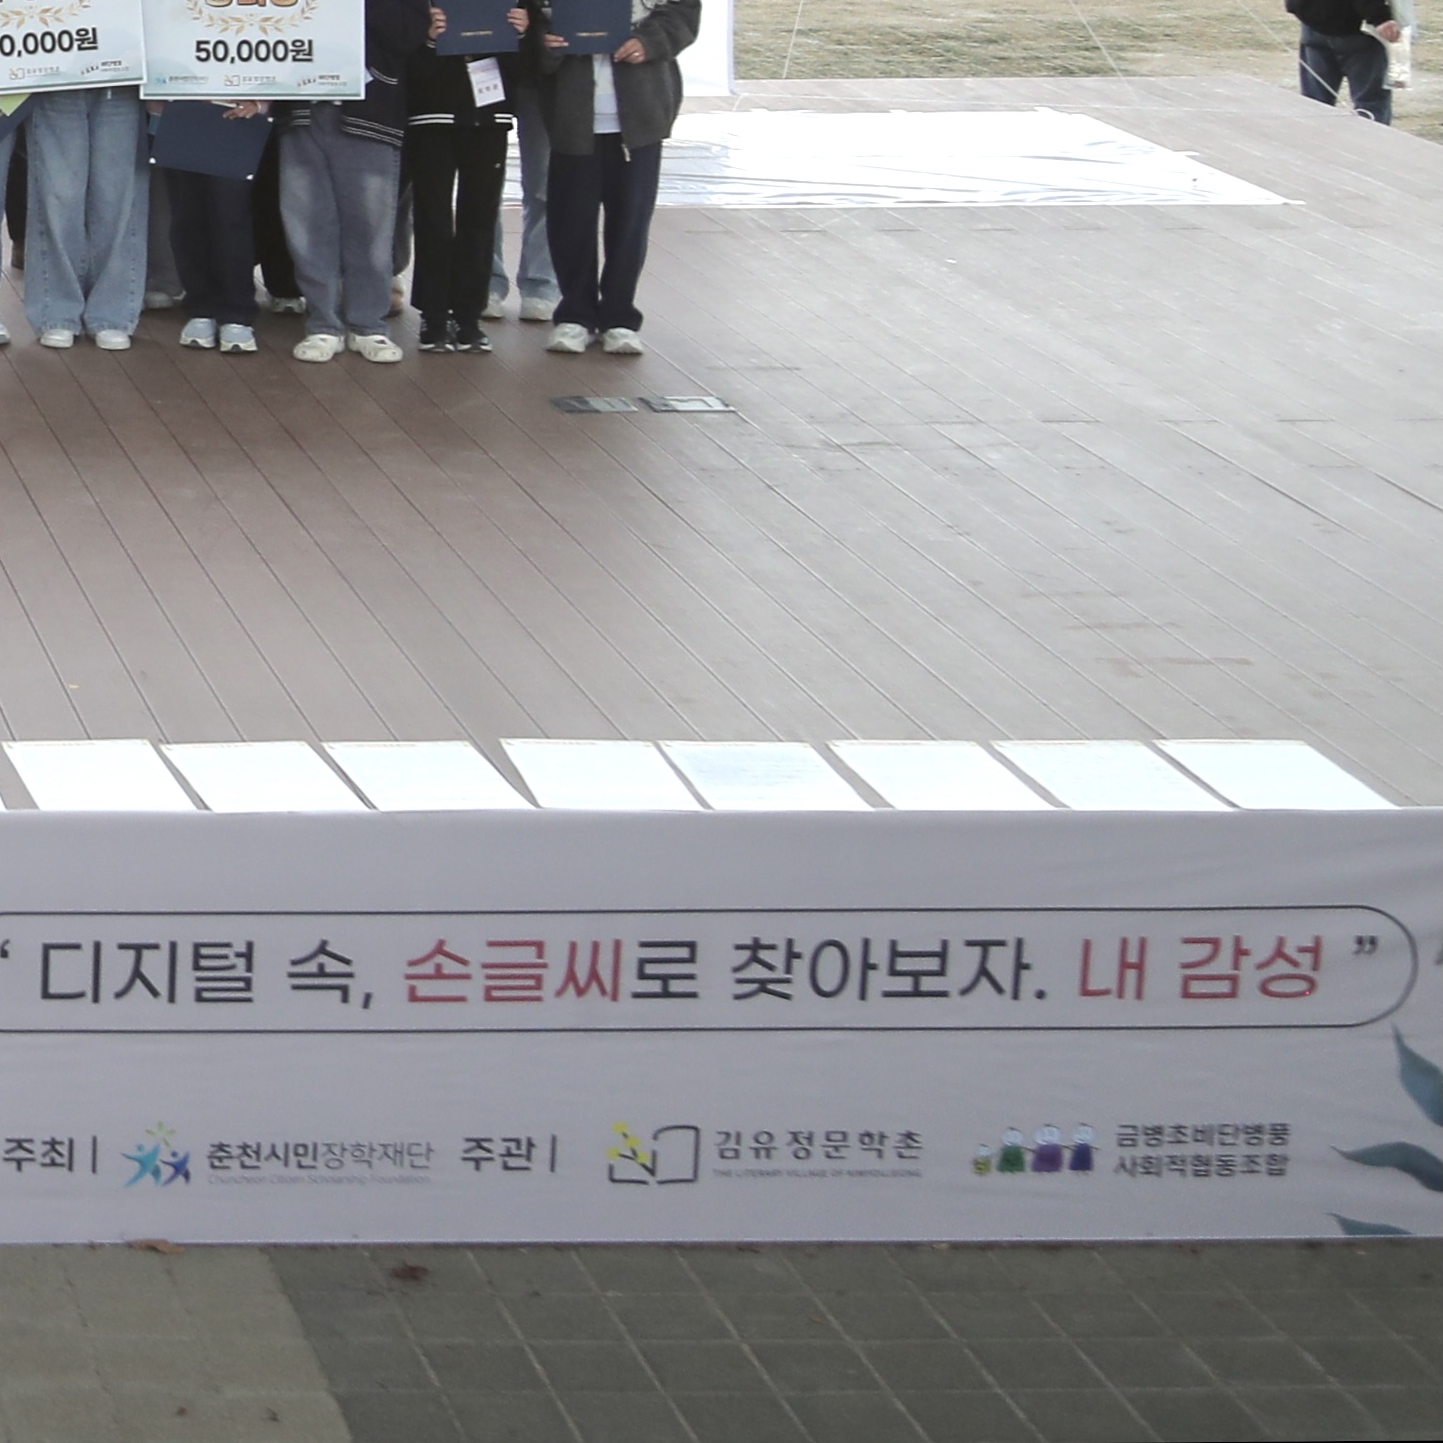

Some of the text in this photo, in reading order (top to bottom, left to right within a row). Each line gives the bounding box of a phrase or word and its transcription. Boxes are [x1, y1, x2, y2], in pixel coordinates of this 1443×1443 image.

[195, 39, 314, 64] 50,000원
[40, 939, 255, 1005] 디지털
[286, 938, 374, 1010] 속,
[403, 938, 700, 1004] 손글씨로
[731, 936, 1048, 1002] 찾아보자.
[1078, 936, 1148, 1001] 내
[1179, 935, 1323, 1000] 감성
[2, 1136, 75, 1173] 주최
[206, 1140, 434, 1171] 춘천시민장학재단
[460, 1136, 537, 1172] 주관
[715, 1129, 924, 1161] 김유정문학촌
